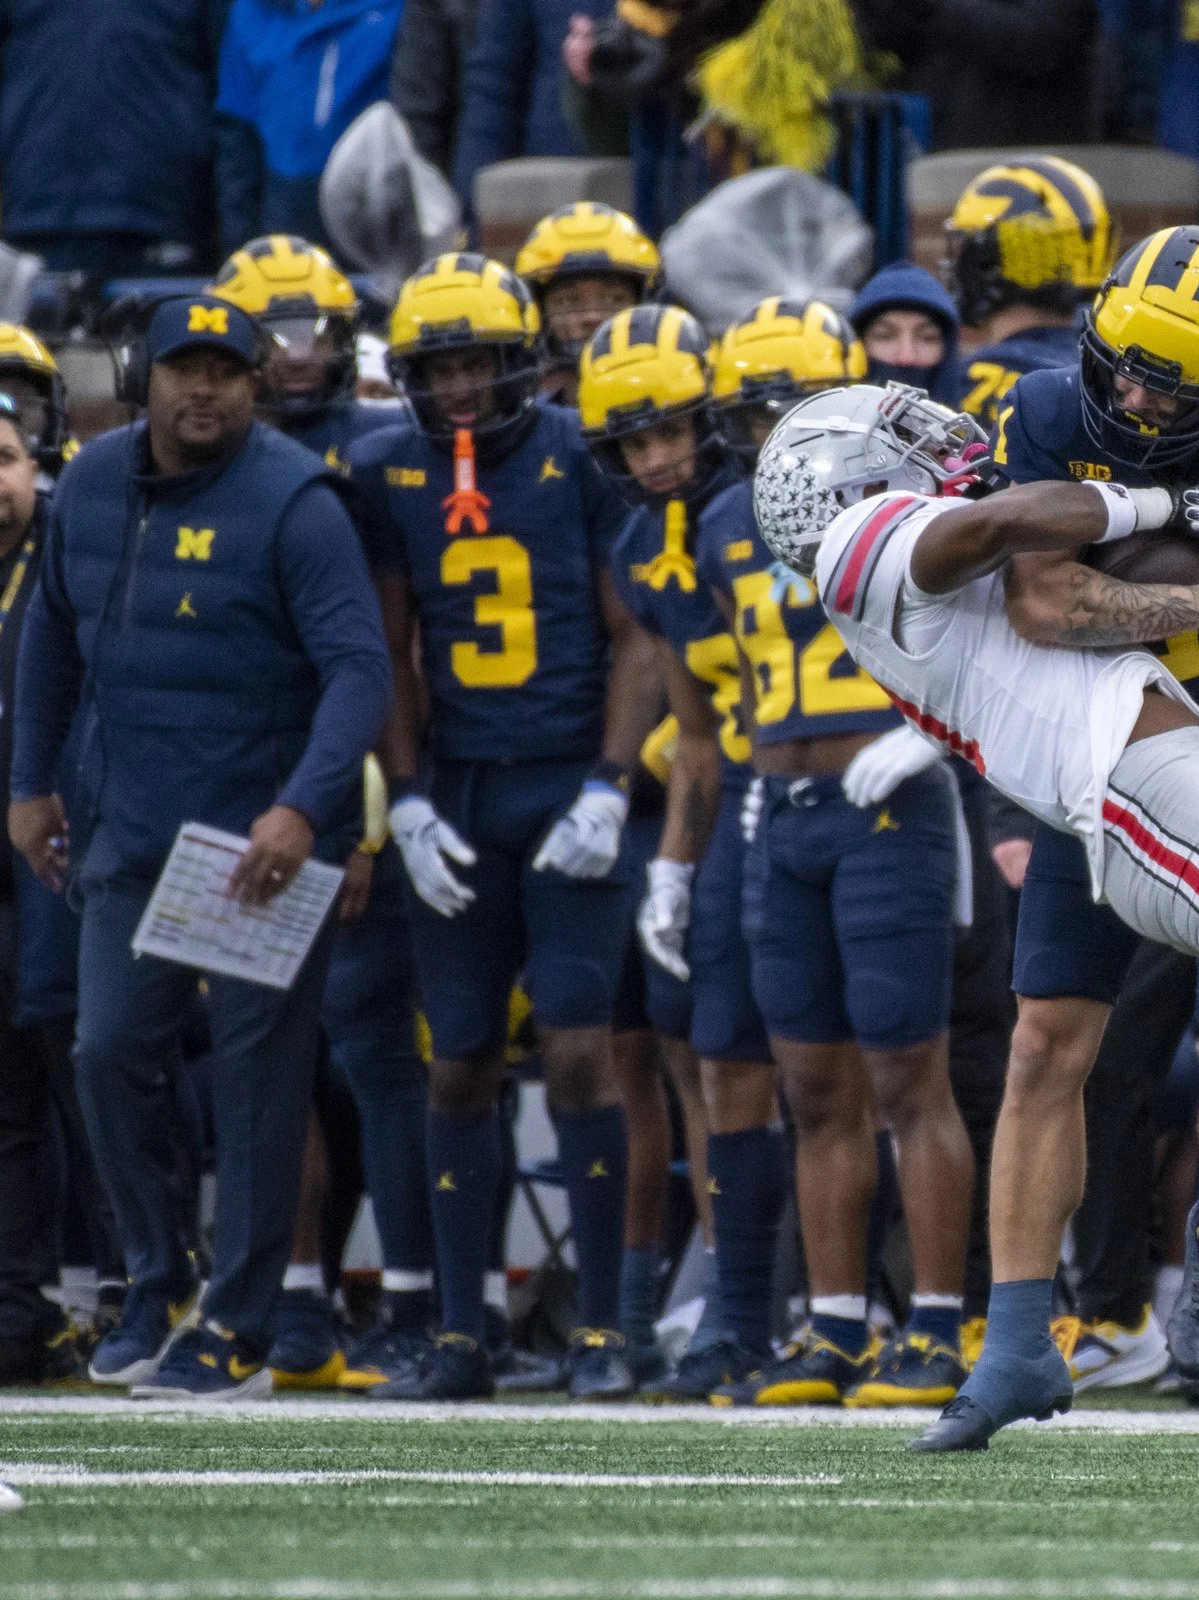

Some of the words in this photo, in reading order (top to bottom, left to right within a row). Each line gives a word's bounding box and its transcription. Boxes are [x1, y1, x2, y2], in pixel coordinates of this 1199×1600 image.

[187, 305, 228, 334] M
[175, 526, 216, 561] M
[440, 535, 538, 688] 3
[732, 571, 894, 726] 82
